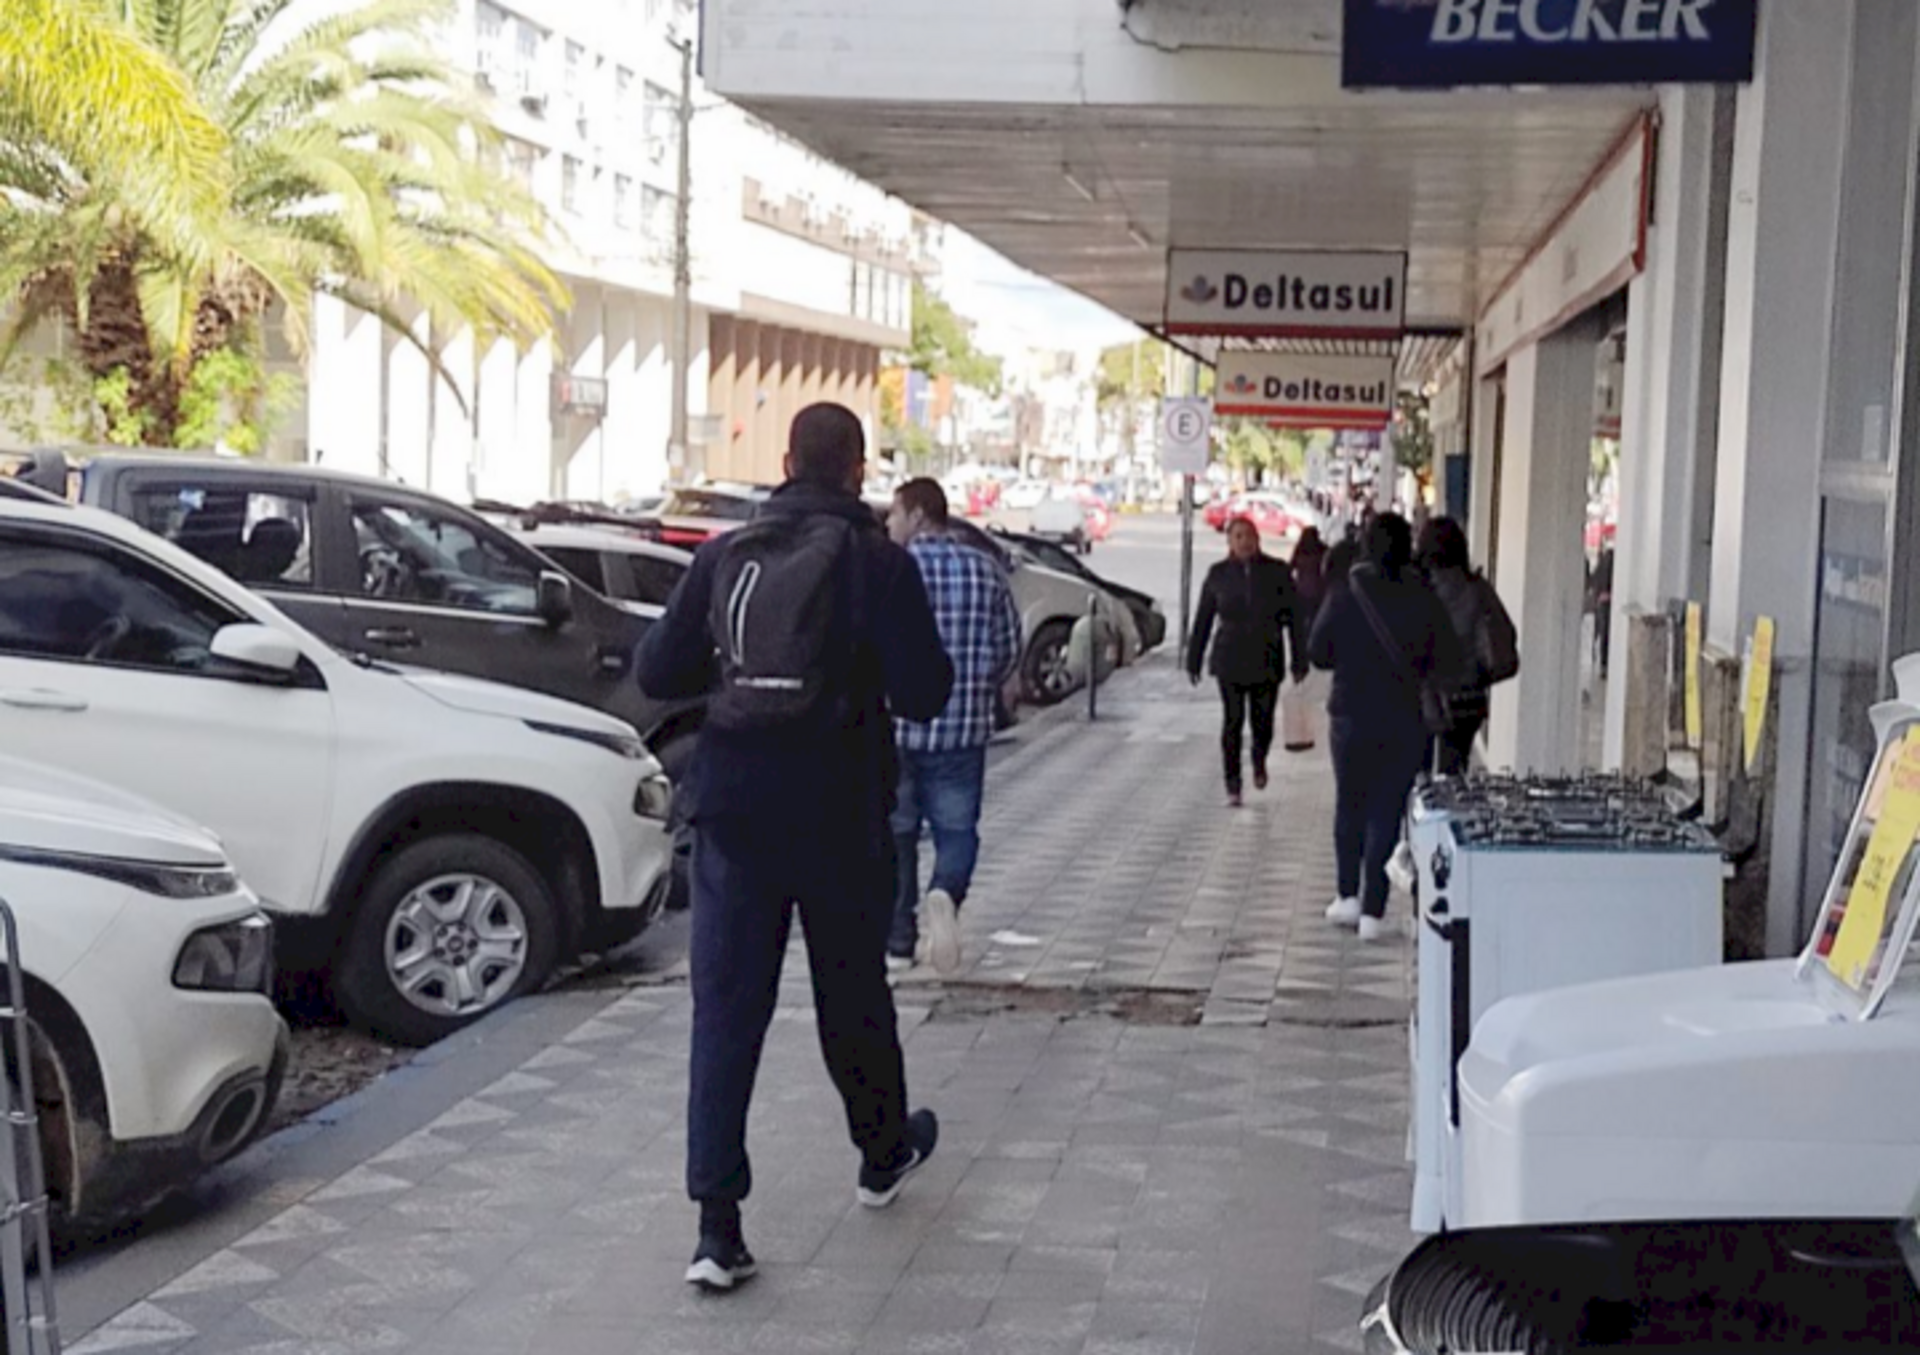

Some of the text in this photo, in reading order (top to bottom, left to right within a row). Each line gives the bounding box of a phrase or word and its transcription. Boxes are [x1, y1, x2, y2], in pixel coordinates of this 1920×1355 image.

[1428, 0, 1710, 43] BECKER
[1223, 273, 1394, 312] Deltasul
[1263, 375, 1386, 404] Deltasul
[1178, 412, 1192, 436] E
